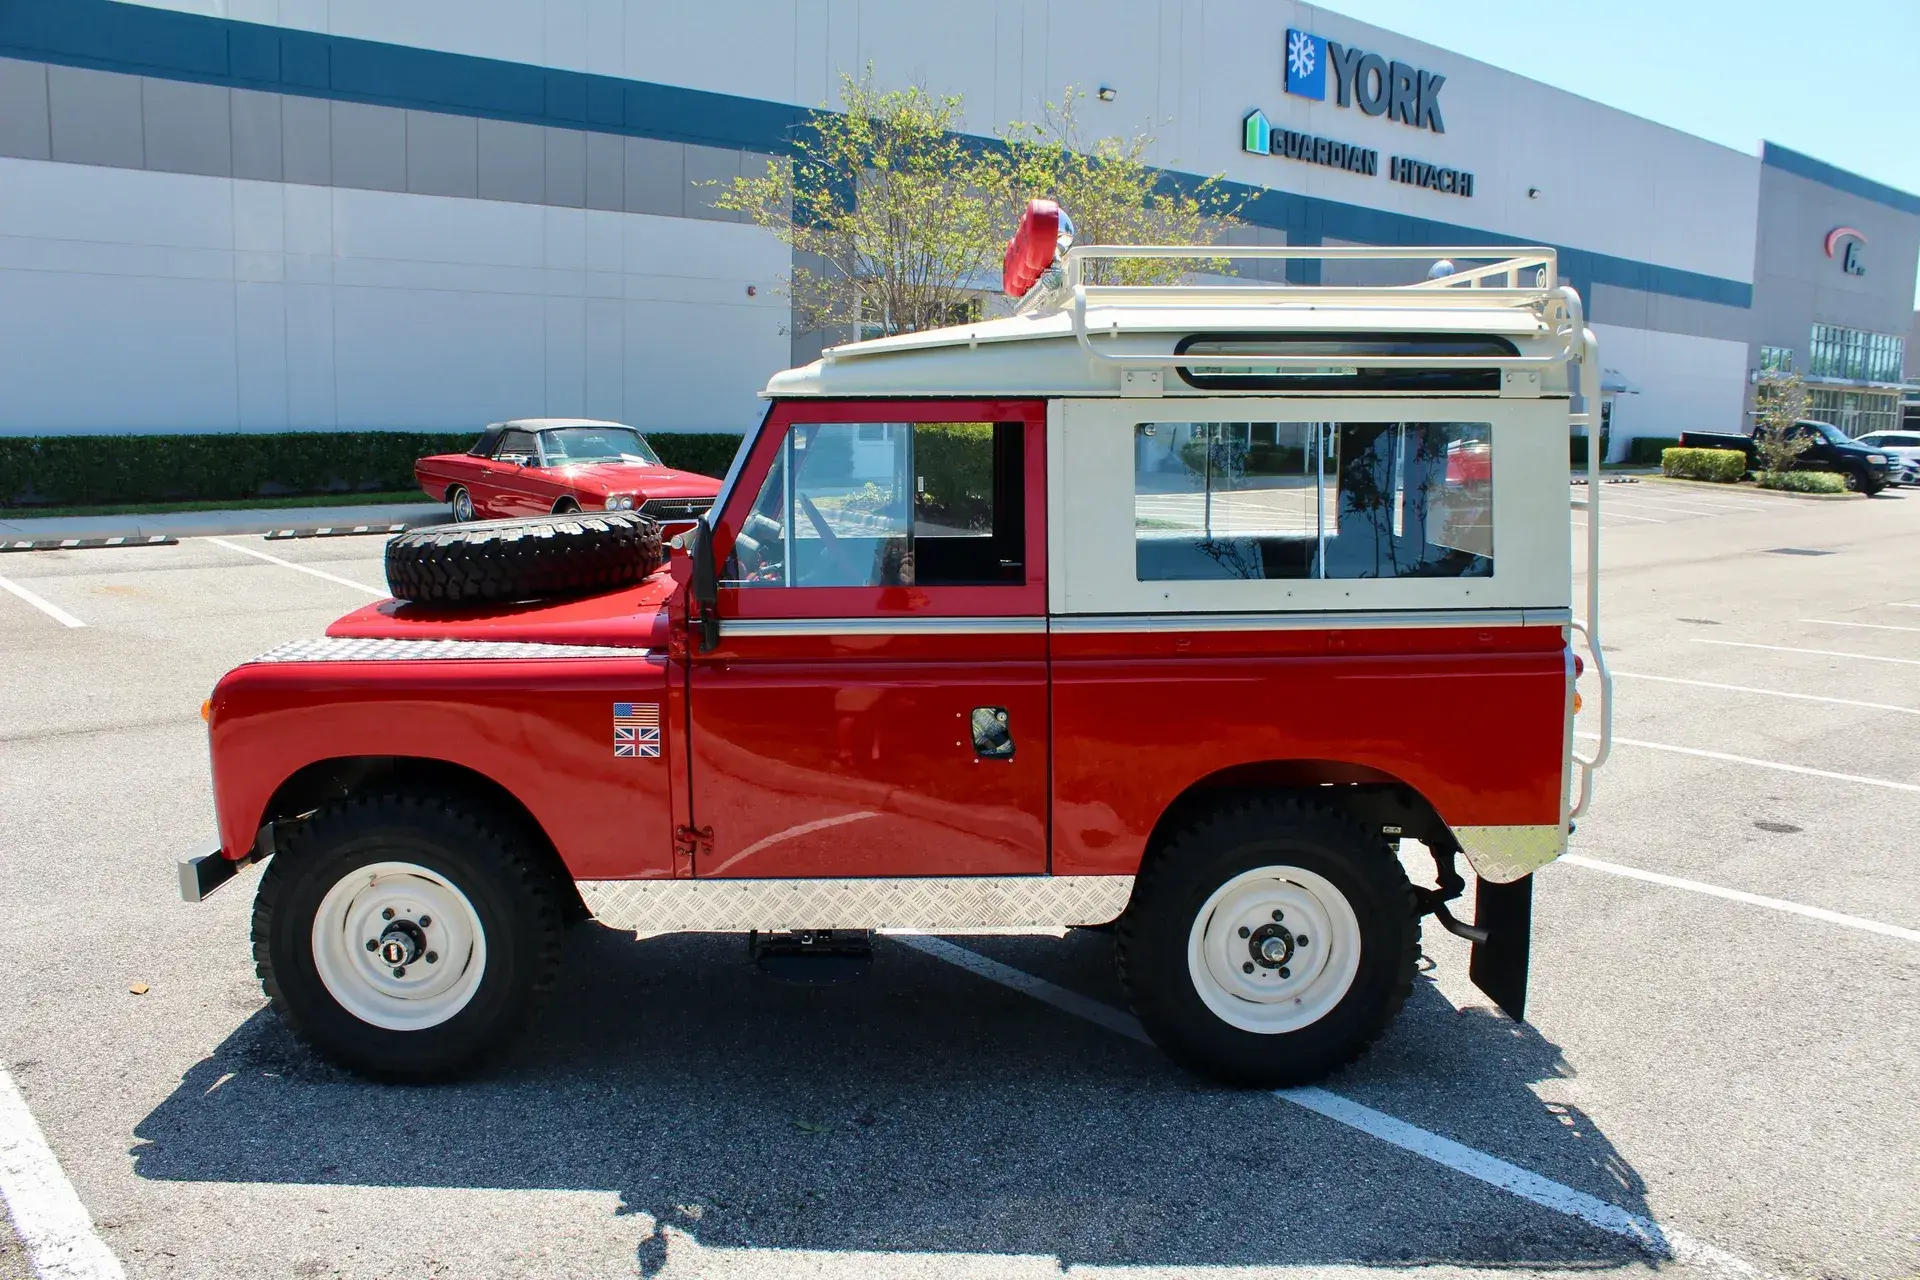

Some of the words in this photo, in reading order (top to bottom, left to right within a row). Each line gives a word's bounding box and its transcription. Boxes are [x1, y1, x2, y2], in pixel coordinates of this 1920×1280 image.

[1327, 41, 1447, 133] YORK
[1270, 128, 1378, 176] GUARDIAN
[1390, 156, 1474, 197] HITACHI
